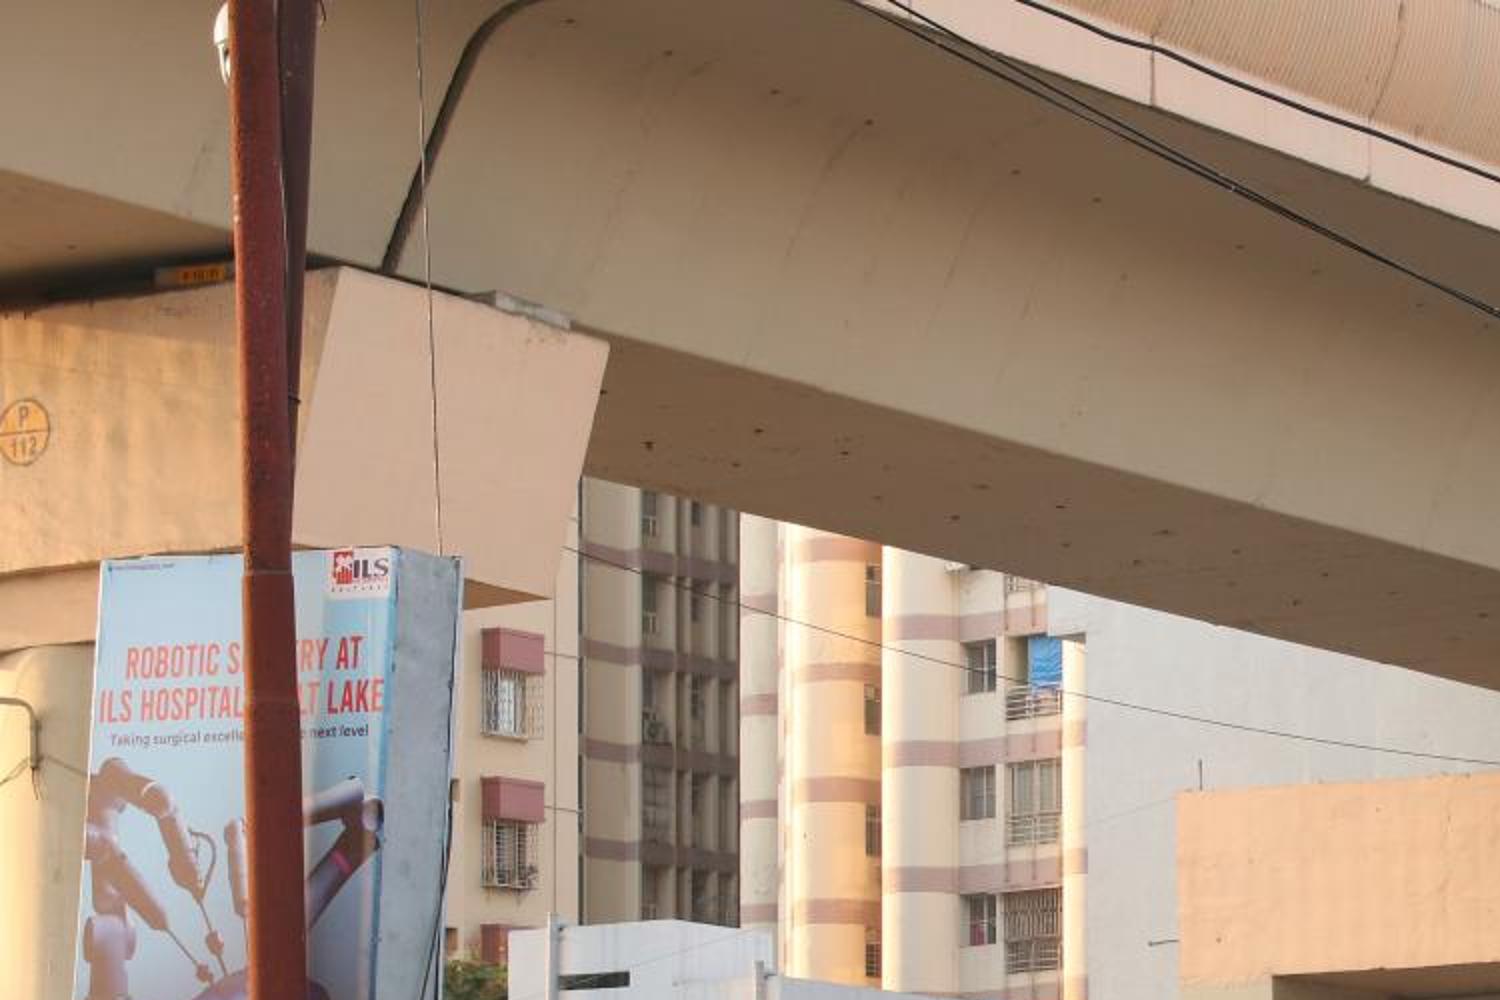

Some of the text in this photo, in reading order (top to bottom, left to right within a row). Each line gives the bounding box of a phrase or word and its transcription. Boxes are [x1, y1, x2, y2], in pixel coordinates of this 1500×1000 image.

[353, 558, 389, 578] ILS
[126, 643, 221, 680] ROBOTIC
[336, 636, 364, 671] AT
[99, 689, 133, 725] ILS
[140, 684, 244, 722] HOSPITAL
[327, 678, 385, 715] LAKE
[339, 723, 369, 737] level
